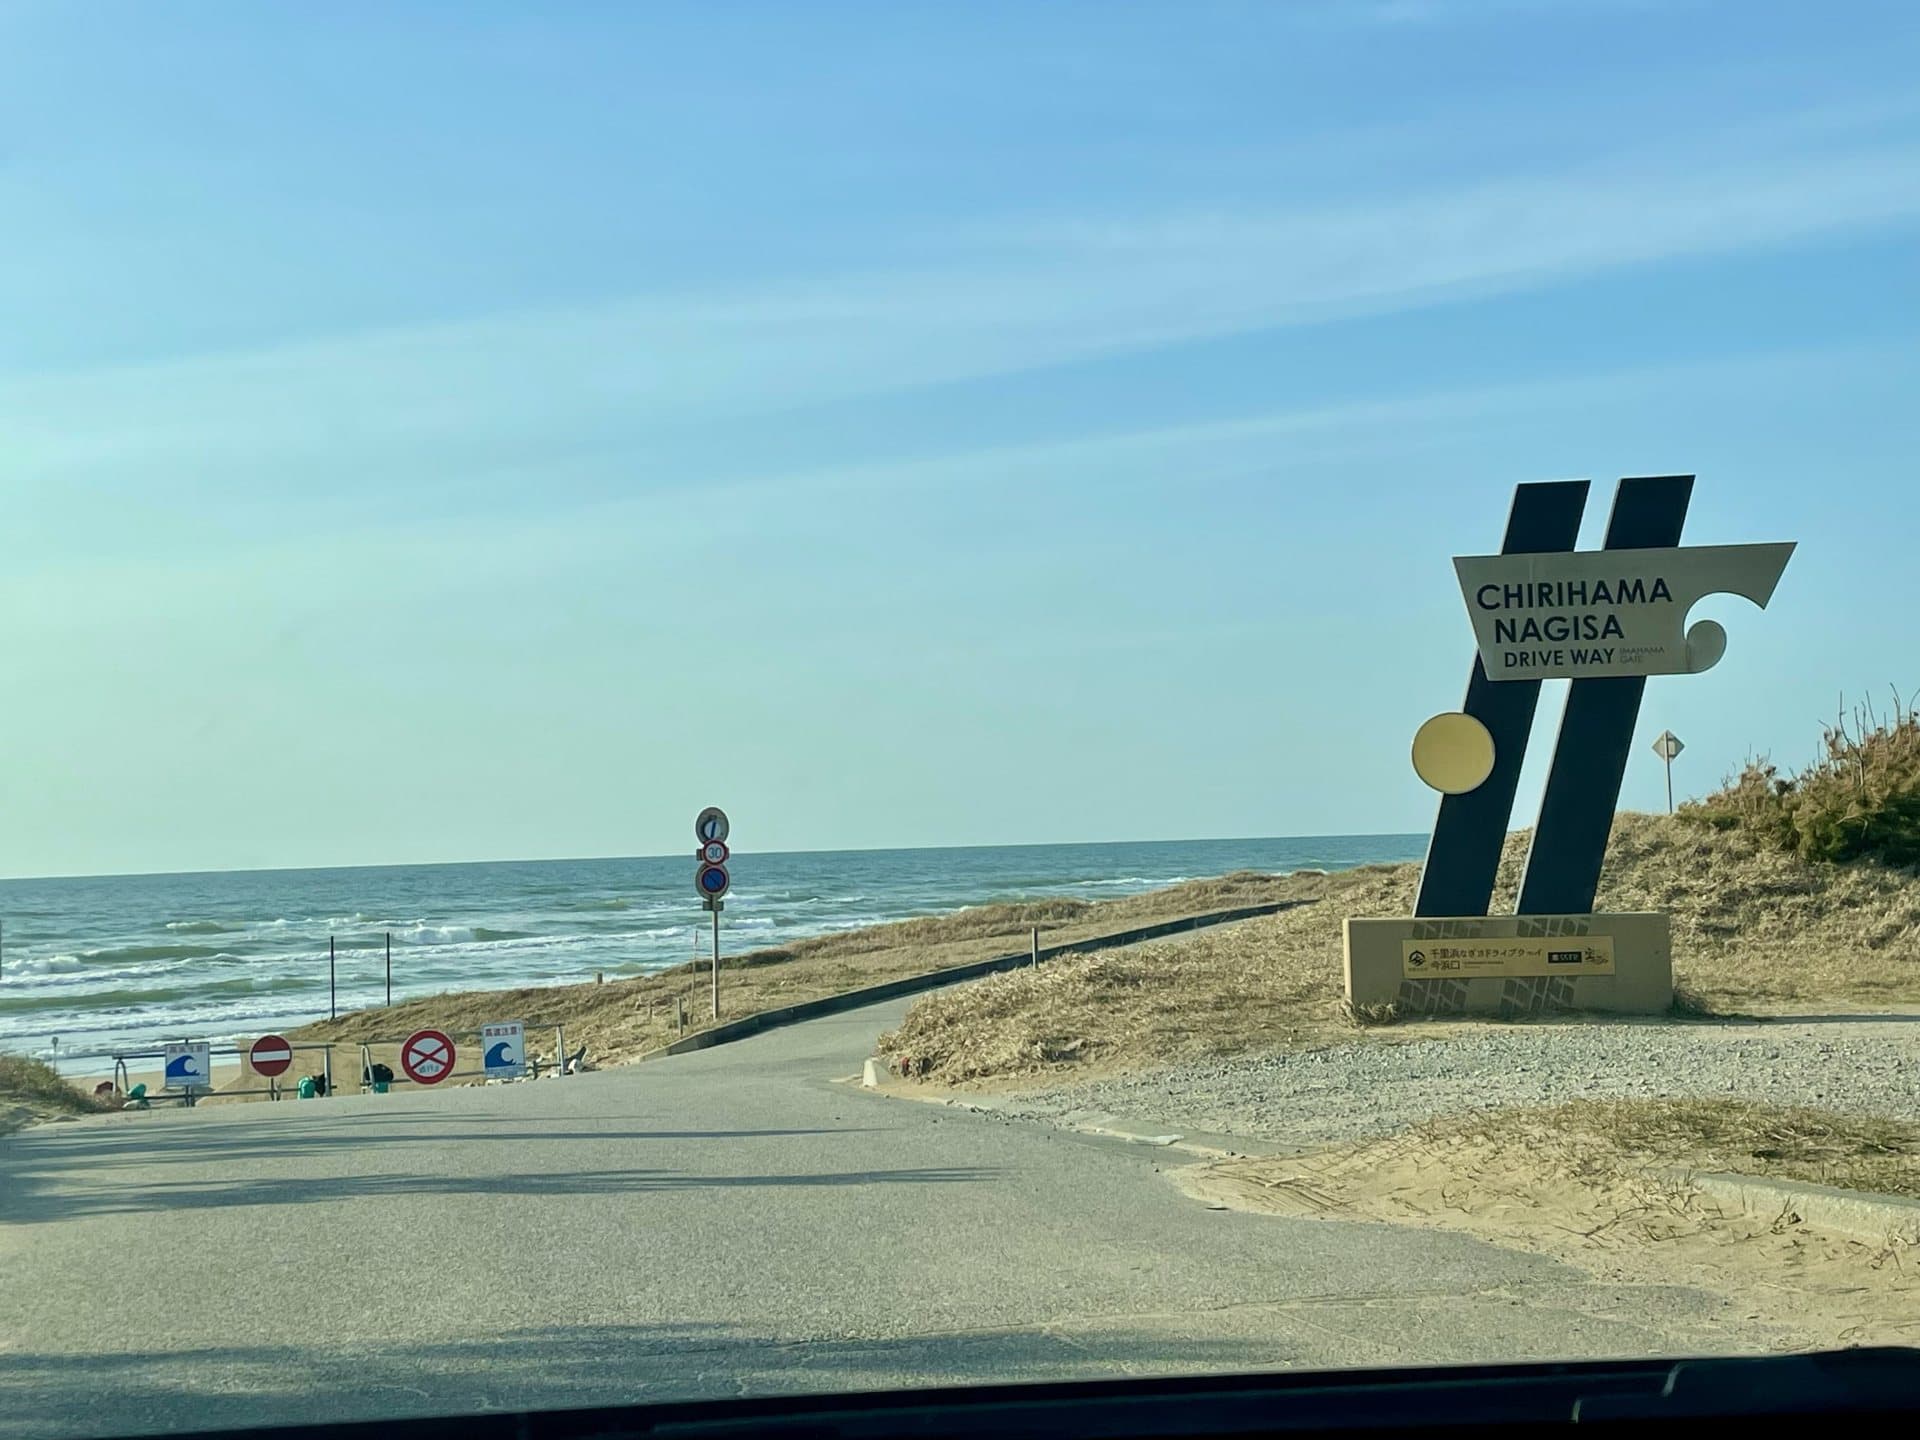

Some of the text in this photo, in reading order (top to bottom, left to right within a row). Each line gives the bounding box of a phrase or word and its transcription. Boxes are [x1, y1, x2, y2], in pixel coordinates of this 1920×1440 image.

[1477, 577, 1673, 610] CHIRIHAMA
[1495, 614, 1625, 643] NAGISA
[1504, 648, 1616, 668] DRIVE WAY
[708, 847, 722, 858] 30
